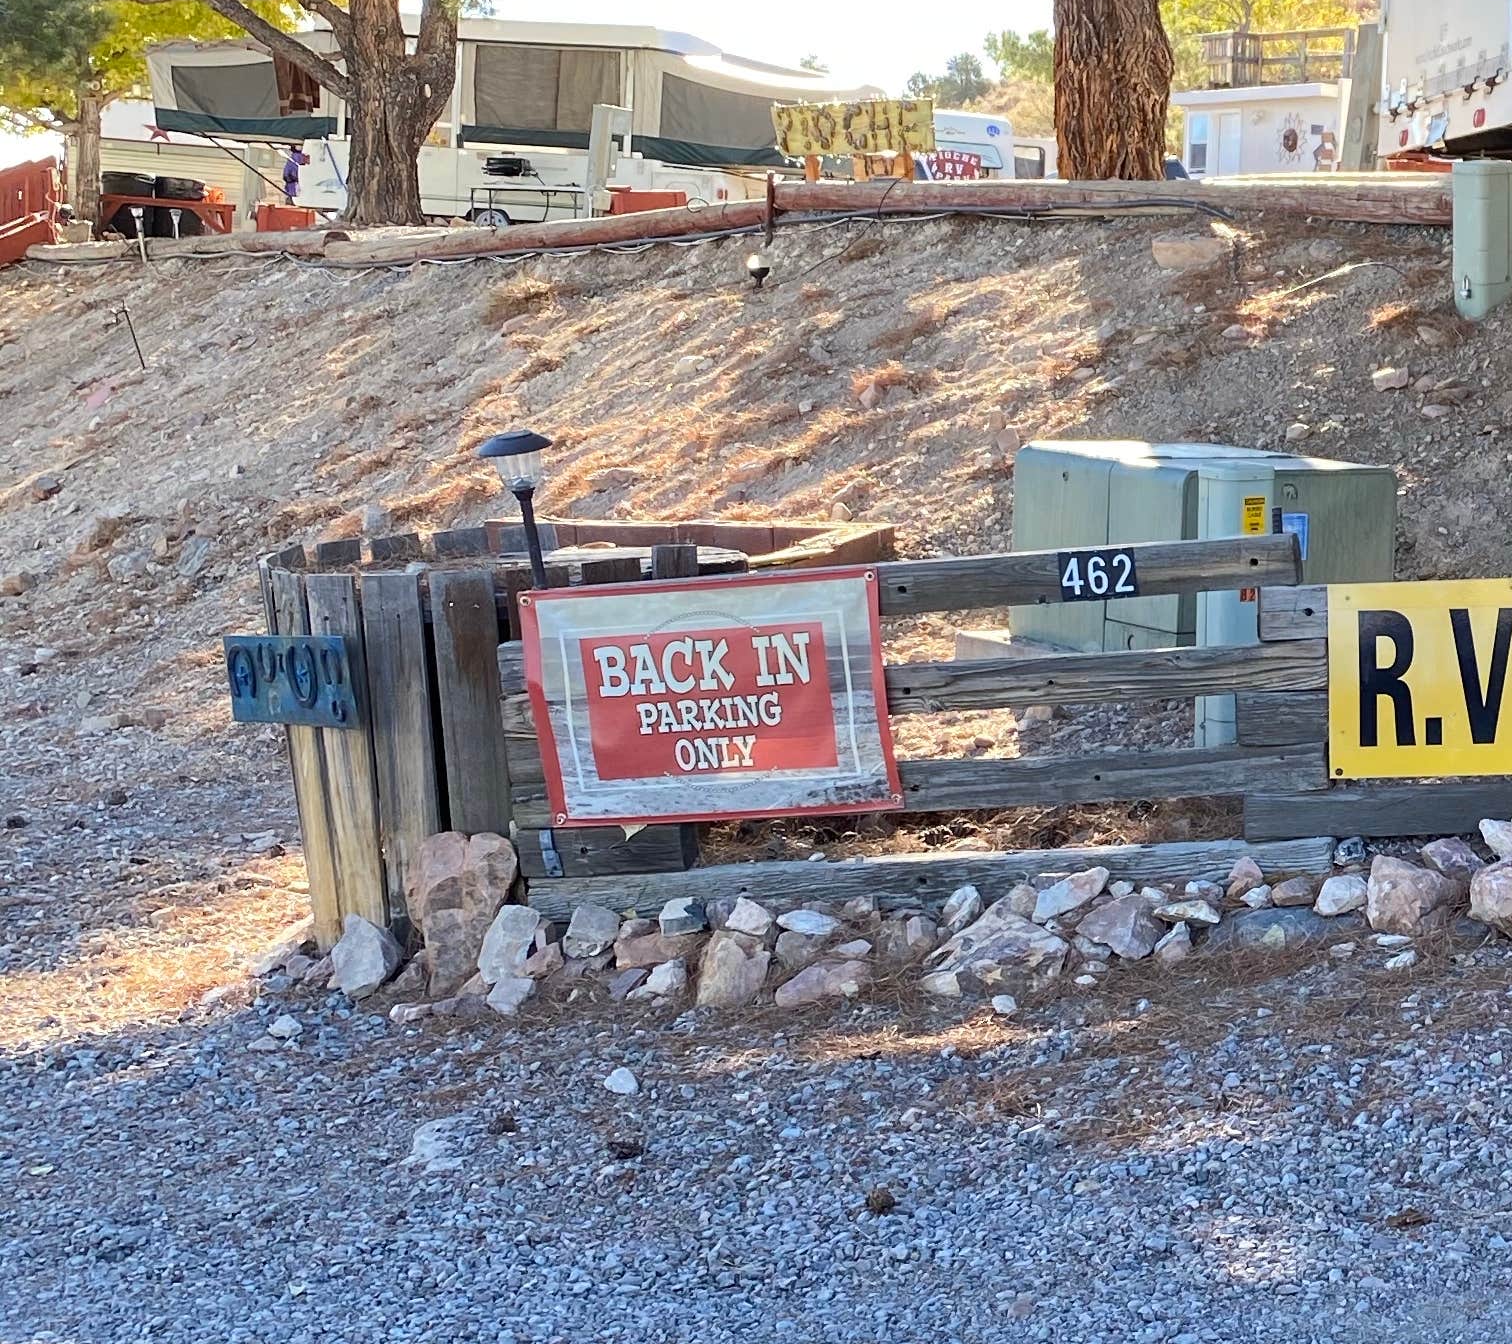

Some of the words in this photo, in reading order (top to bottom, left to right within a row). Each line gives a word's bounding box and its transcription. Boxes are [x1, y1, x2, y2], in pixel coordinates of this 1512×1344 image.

[945, 162, 964, 174] RV
[1062, 554, 1134, 595] 462
[593, 636, 736, 698] BACK
[752, 631, 811, 687] IN
[636, 691, 782, 735] PARKING
[675, 734, 756, 772] ONLY
